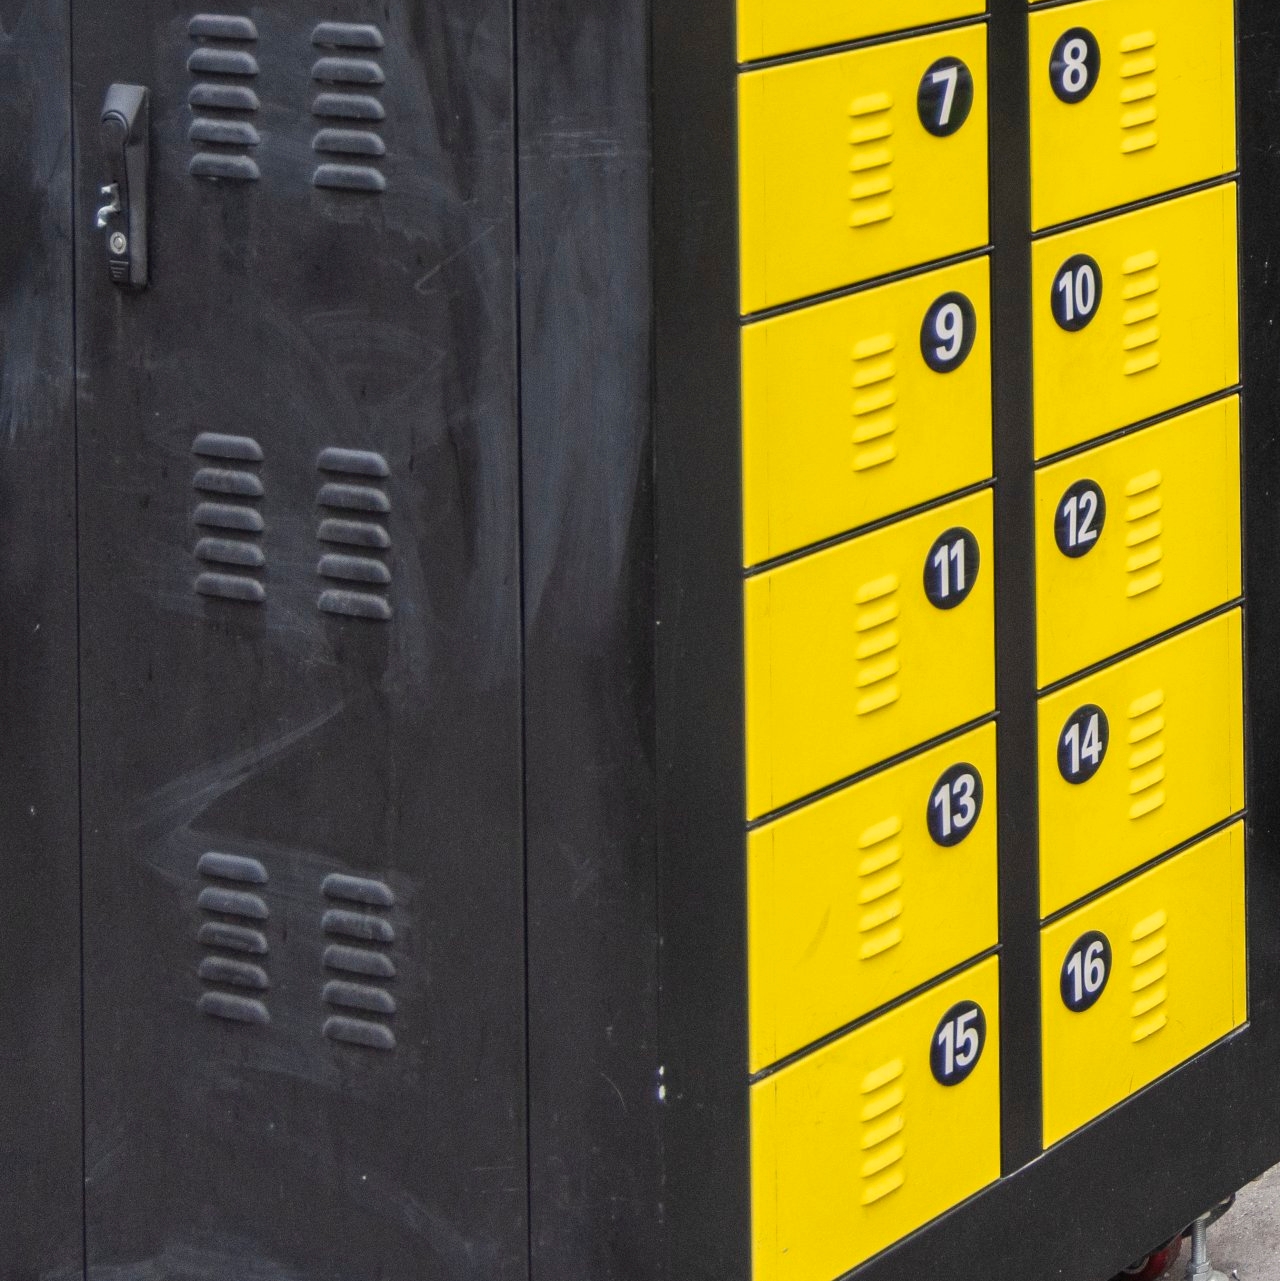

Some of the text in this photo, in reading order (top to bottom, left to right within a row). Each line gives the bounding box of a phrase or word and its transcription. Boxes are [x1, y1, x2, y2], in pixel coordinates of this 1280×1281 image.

[1062, 38, 1088, 93] 8
[931, 66, 958, 126] 7
[1059, 264, 1095, 321] 10
[935, 302, 963, 361] 9
[1063, 490, 1098, 547] 12
[934, 538, 965, 598] 11
[1064, 713, 1103, 774] 14
[934, 773, 976, 837] 13
[1067, 940, 1105, 1002] 16
[938, 1008, 979, 1075] 15
